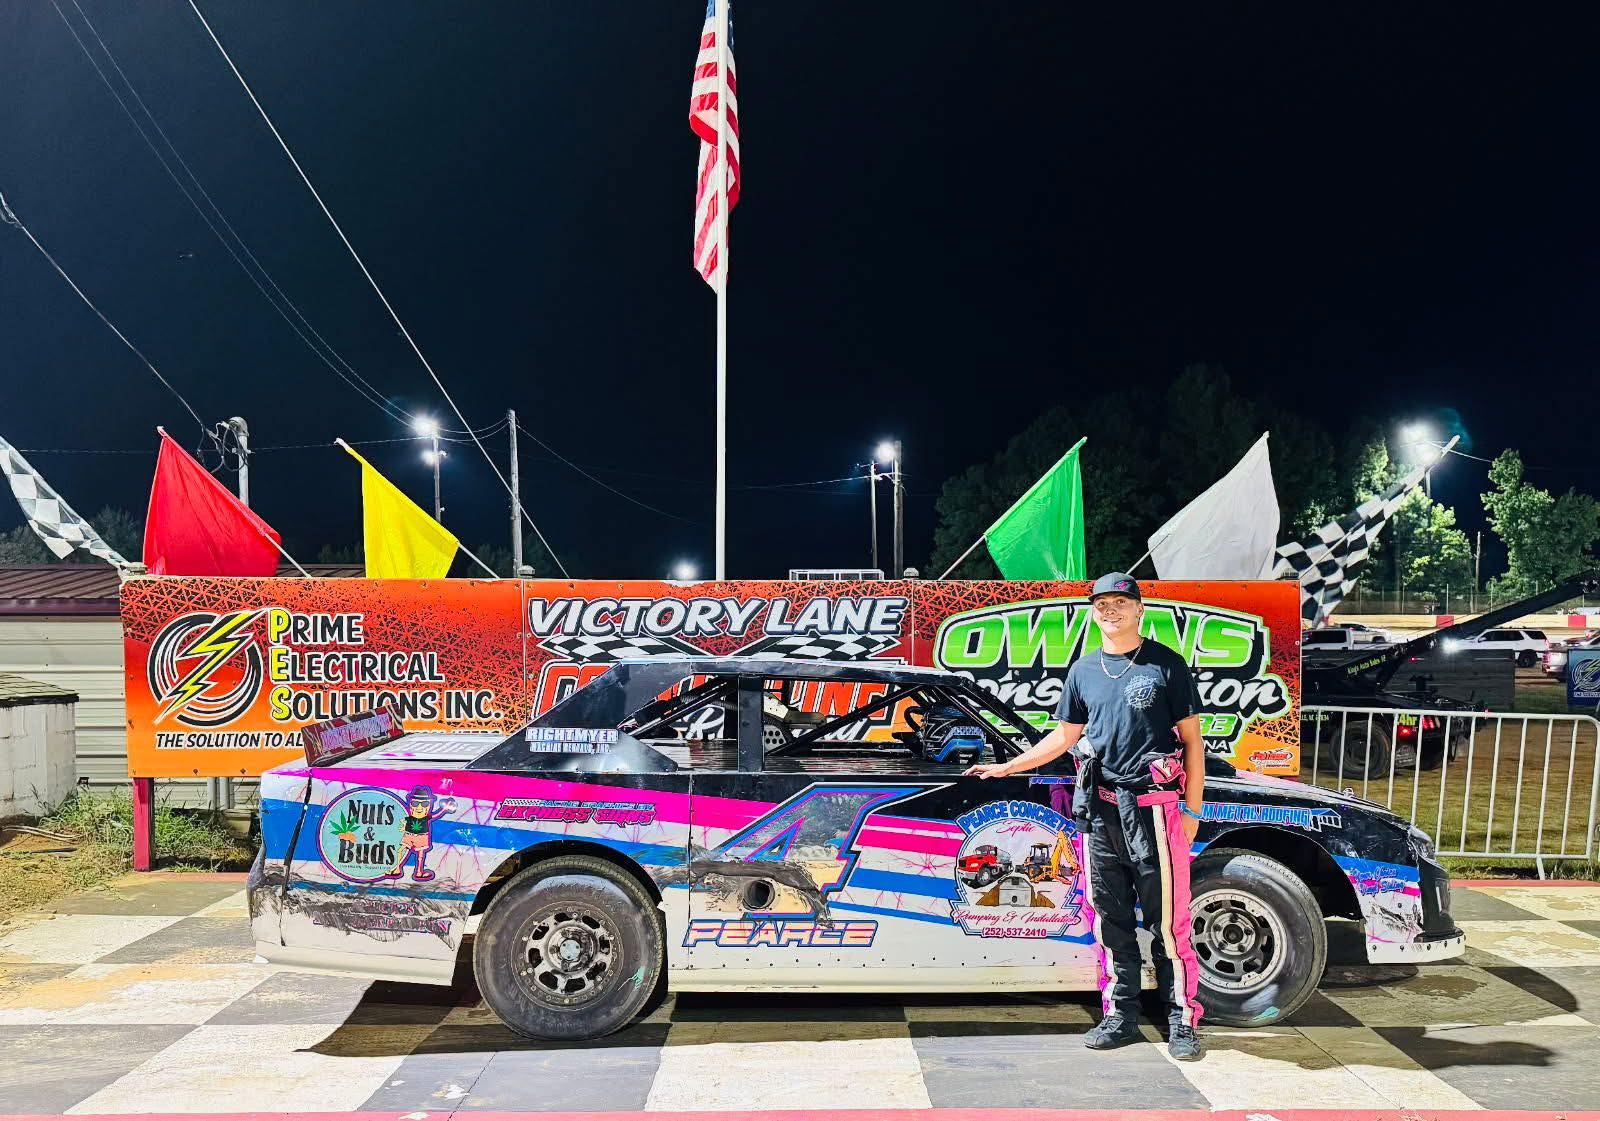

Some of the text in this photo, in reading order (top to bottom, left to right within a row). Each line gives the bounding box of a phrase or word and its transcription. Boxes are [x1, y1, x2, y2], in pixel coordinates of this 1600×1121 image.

[270, 609, 363, 643] PRIME
[529, 598, 909, 637] VICTORY LANE
[938, 604, 1257, 668] OWNS
[271, 649, 444, 682] ELECTRICAL
[445, 690, 502, 720] INC.
[157, 732, 304, 748] THE SOLUTION TO AL
[526, 728, 618, 743] RIGHTMYER
[347, 799, 395, 825] Nuts
[957, 802, 1008, 834] PEARCE
[1217, 803, 1257, 823] METAL
[363, 827, 376, 841] &
[996, 820, 1035, 837] Septic
[338, 839, 396, 865] Buds
[954, 910, 1000, 924] Pumping
[1021, 911, 1078, 924] Installation
[682, 919, 878, 947] PEARCE
